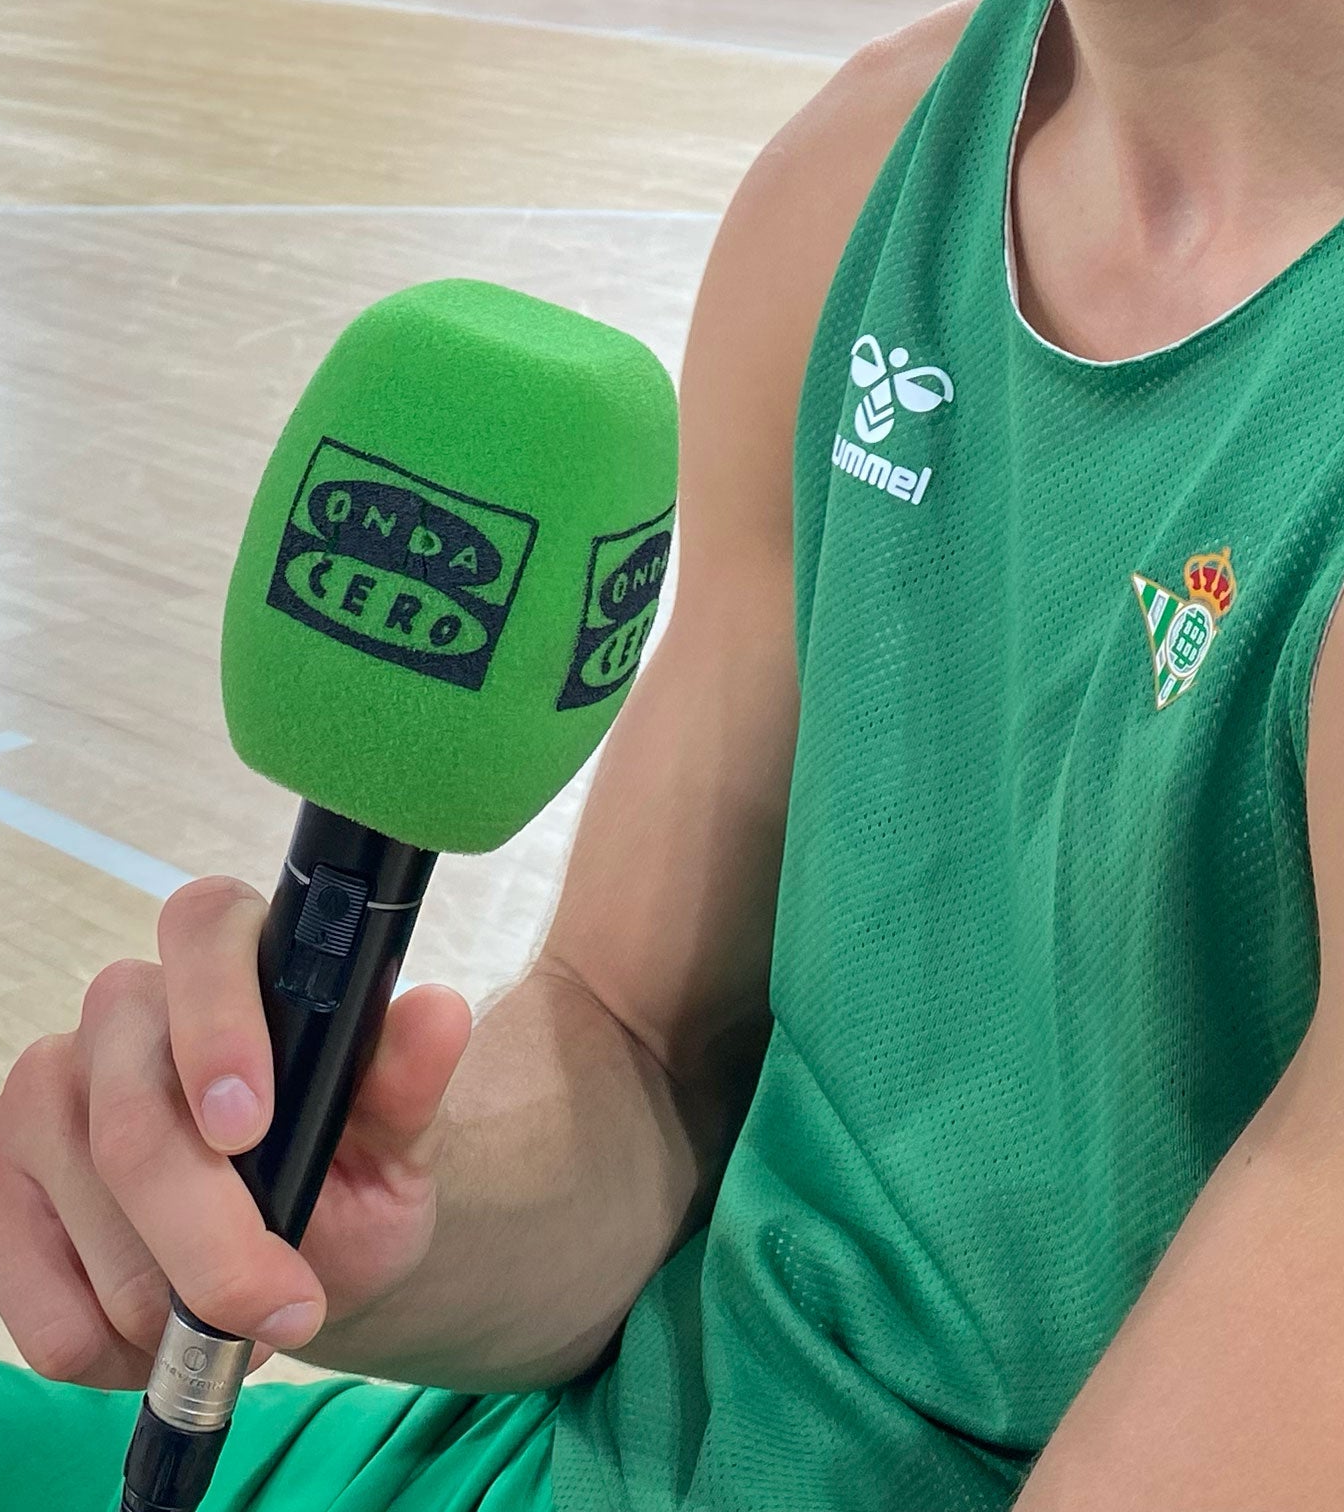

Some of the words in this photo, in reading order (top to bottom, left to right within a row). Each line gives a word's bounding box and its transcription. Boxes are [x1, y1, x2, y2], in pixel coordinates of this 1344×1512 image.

[831, 433, 933, 506] ummel
[324, 488, 479, 576] ONDA
[308, 556, 463, 648] CERO
[612, 545, 669, 605] OND
